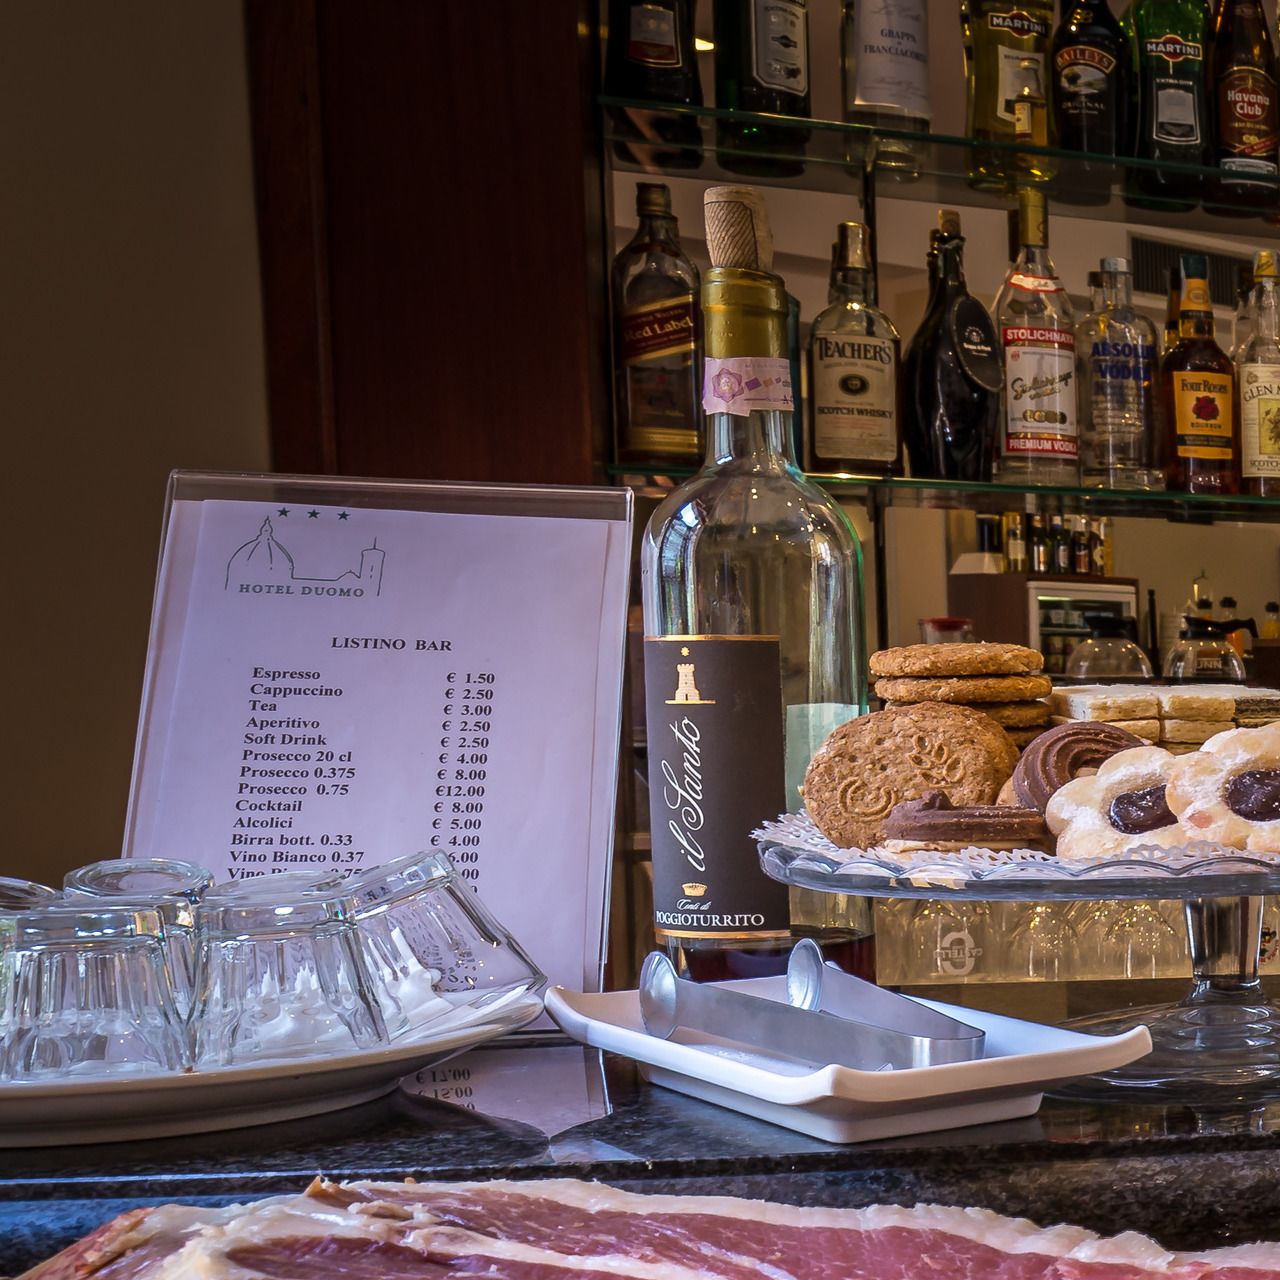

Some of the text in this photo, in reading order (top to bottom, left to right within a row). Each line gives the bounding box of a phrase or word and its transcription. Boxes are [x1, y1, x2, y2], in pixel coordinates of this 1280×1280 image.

[992, 15, 1047, 35] MARTINI
[1146, 42, 1200, 58] MARTINI
[1227, 90, 1271, 106] Havana
[1236, 103, 1262, 116] Club
[815, 337, 893, 365] TEACHER'S
[1243, 384, 1275, 403] GLEN
[817, 406, 855, 416] SCOTCH
[1009, 440, 1052, 451] PREMIUM
[239, 584, 365, 598] HOTEL DUOMO
[331, 636, 452, 653] LISTINO BAR
[252, 667, 495, 684] Espresso € 1.50
[250, 683, 494, 700] Cappuccino € 2.50
[248, 699, 492, 716] Tea € 3.00
[246, 716, 491, 732] Aperitivo € 2.50
[243, 733, 489, 748] Soft Drink € 2.50
[242, 749, 488, 764] Prosecco 20 cl € 4.00
[240, 766, 486, 781] Prosecco 0.375 € 8.00
[237, 782, 485, 797] Prosecco 0.75 €12.00
[660, 715, 707, 873] il Santo
[235, 799, 483, 814] Cocktail € 8.00
[233, 816, 482, 830] Alcolici € 5.00
[230, 833, 480, 847] Birra bott. 0.33 € 4.00
[230, 850, 267, 863] Vino
[271, 850, 327, 863] Bianco
[331, 851, 365, 863] 0.37
